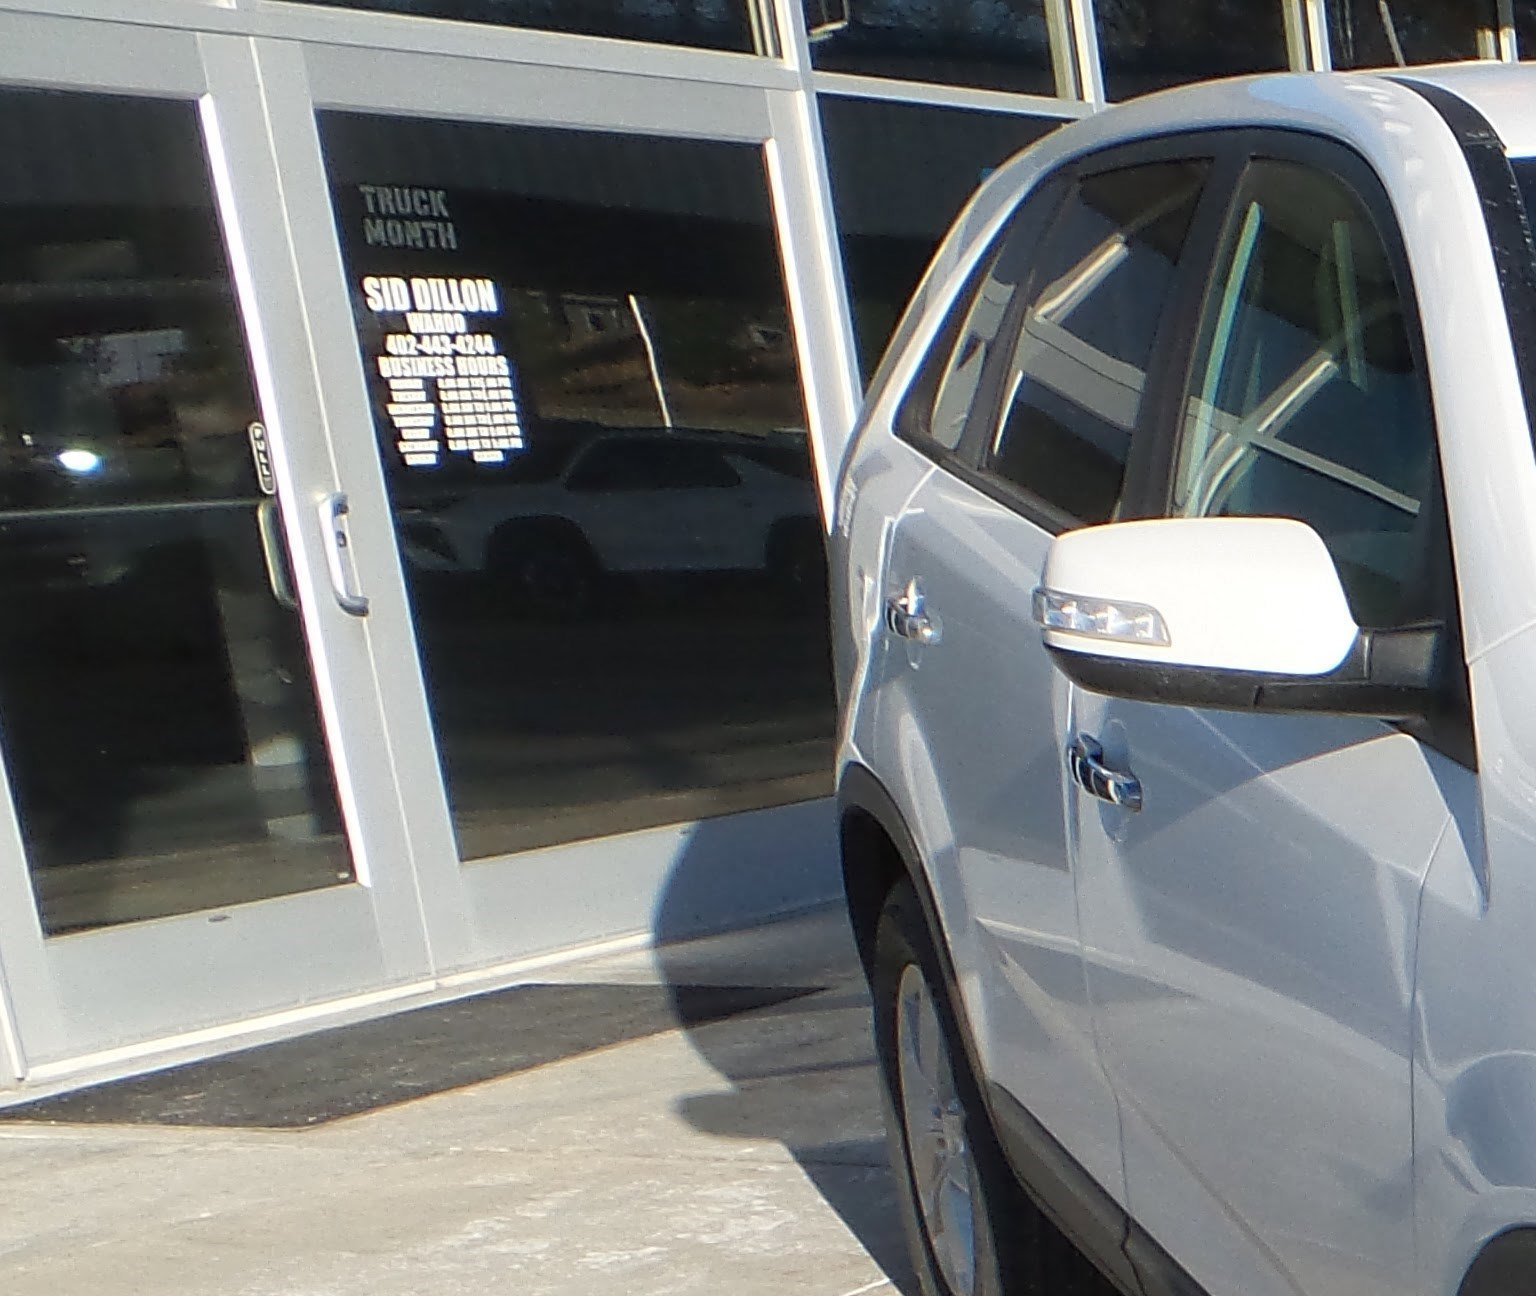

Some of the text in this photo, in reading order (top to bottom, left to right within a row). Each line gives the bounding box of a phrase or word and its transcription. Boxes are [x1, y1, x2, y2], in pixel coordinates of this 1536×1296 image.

[359, 184, 449, 217] TRUCK
[363, 217, 458, 250] MONTH
[363, 276, 498, 312] SID DILLON
[405, 312, 466, 333] WAHOO
[385, 334, 495, 355] 402-443-4244
[377, 355, 509, 378] BUSINESS HOURS
[254, 428, 270, 475] PULL
